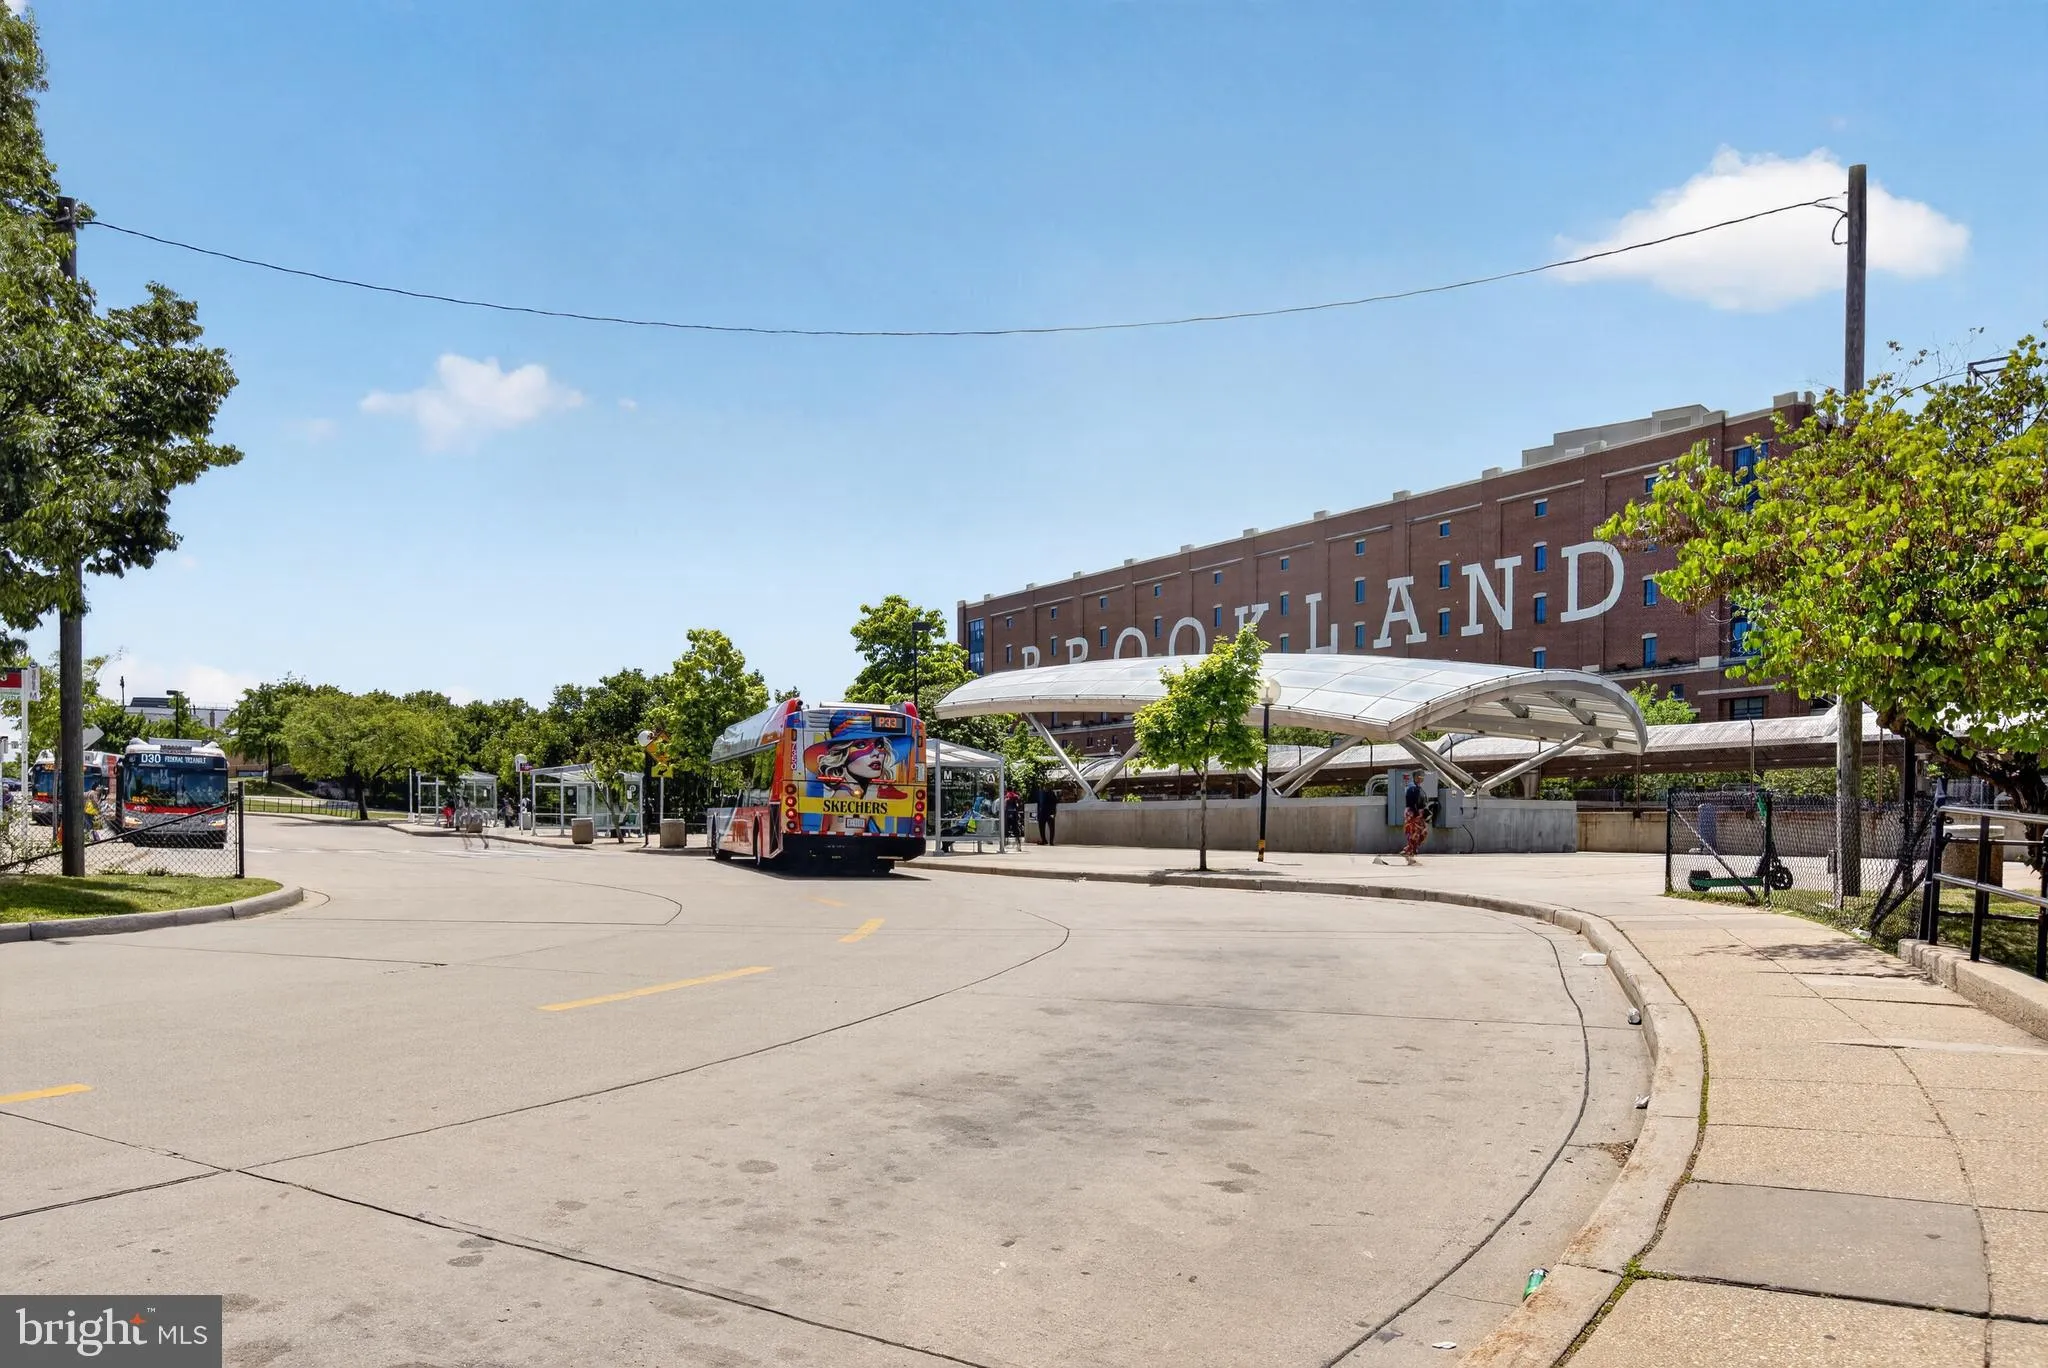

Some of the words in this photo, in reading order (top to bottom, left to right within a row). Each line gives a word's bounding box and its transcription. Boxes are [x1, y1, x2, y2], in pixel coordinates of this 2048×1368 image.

[879, 717, 897, 728] P33
[141, 753, 161, 763] D30
[943, 770, 953, 780] M
[823, 799, 888, 814] SKECHERS
